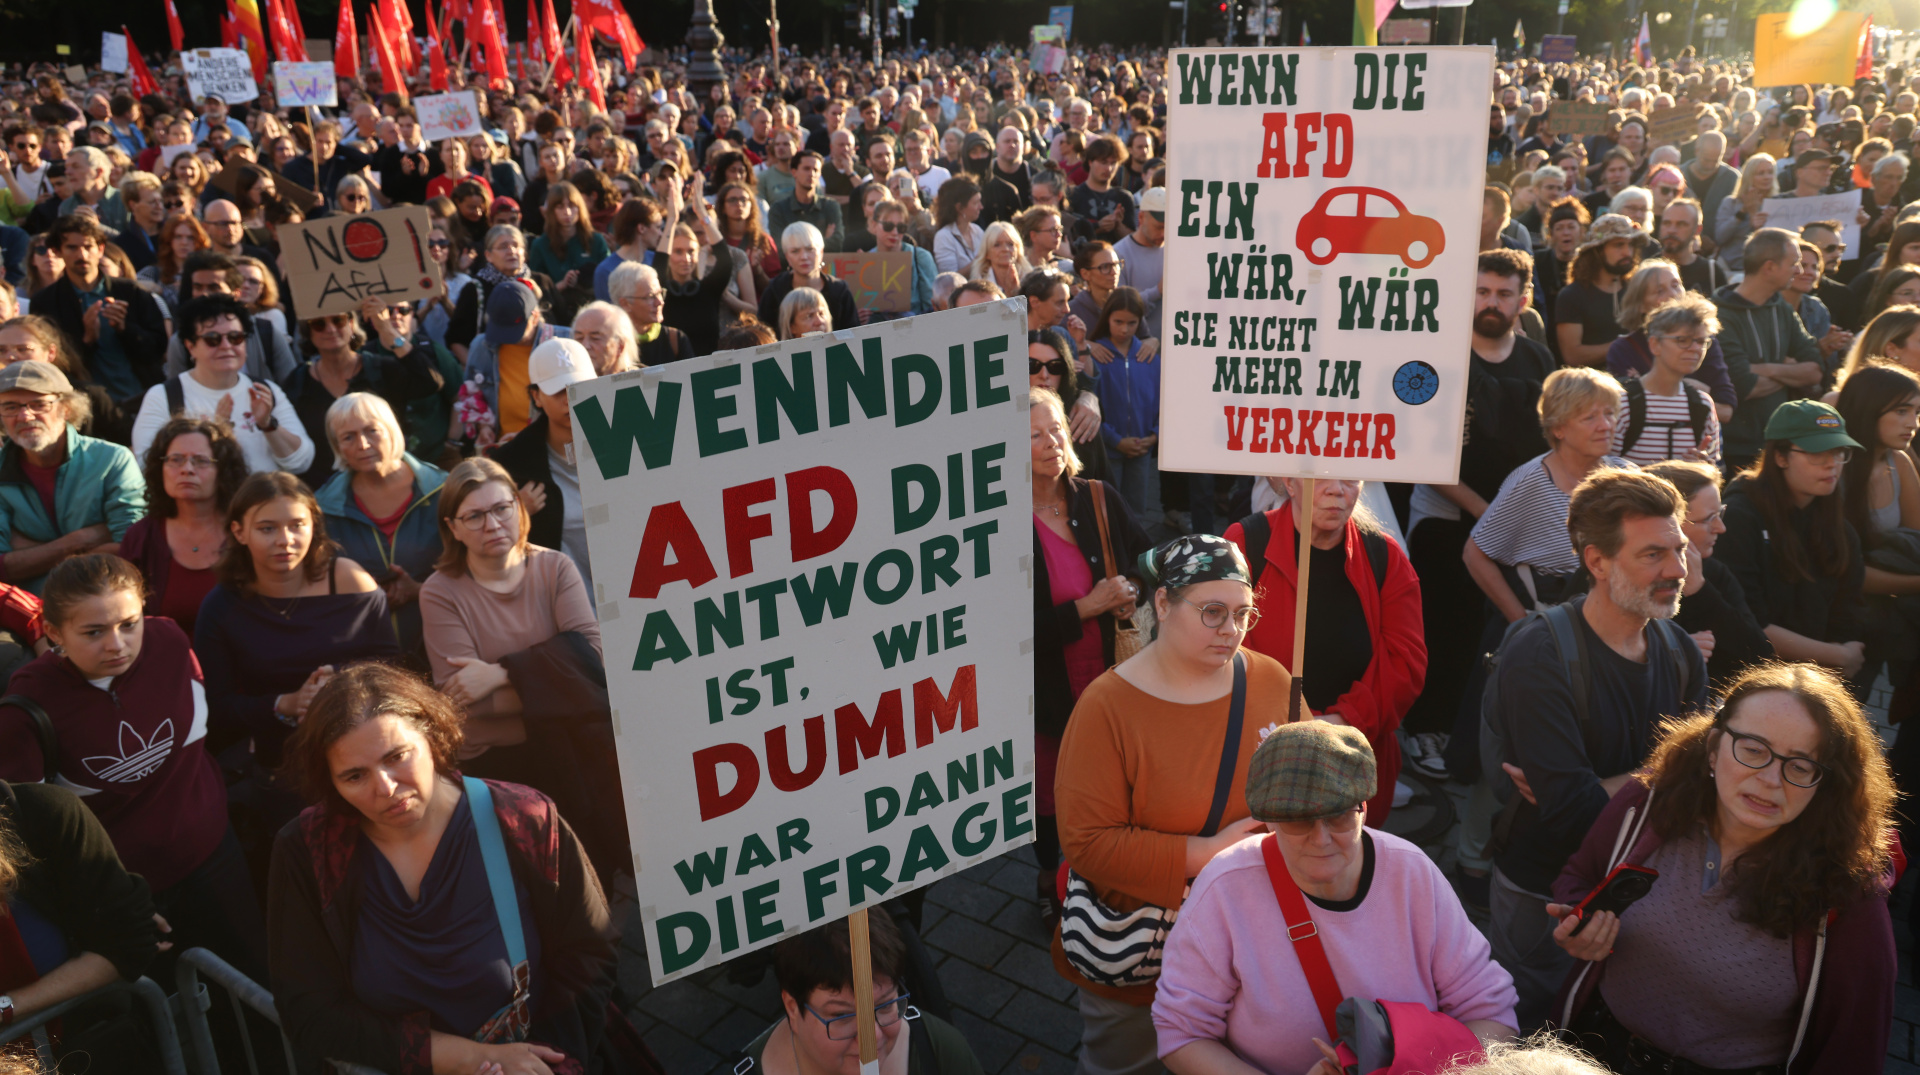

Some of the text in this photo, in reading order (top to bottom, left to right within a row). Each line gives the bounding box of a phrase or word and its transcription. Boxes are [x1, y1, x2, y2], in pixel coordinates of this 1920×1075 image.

[188, 68, 254, 81] MENSCHEN
[1177, 53, 1427, 111] WENN DIE
[1257, 112, 1353, 178] AFD
[1178, 180, 1259, 240] EIN
[303, 217, 388, 270] NO
[1207, 245, 1306, 305] WÄR,
[1174, 311, 1317, 352] SIE NICHT
[1338, 267, 1439, 332] WÄR
[573, 335, 1010, 480] WENN DIE
[1212, 356, 1302, 395] MEHR
[1316, 359, 1361, 399] IM
[1224, 406, 1396, 459] VERKEHR
[629, 443, 1007, 599] AFD DIE
[632, 520, 999, 671] ANTWORT
[705, 605, 967, 724] IST, WIE
[692, 664, 979, 822] DUMM
[673, 739, 1014, 895] WAR DANN
[655, 781, 1033, 975] DIE FRAGE
